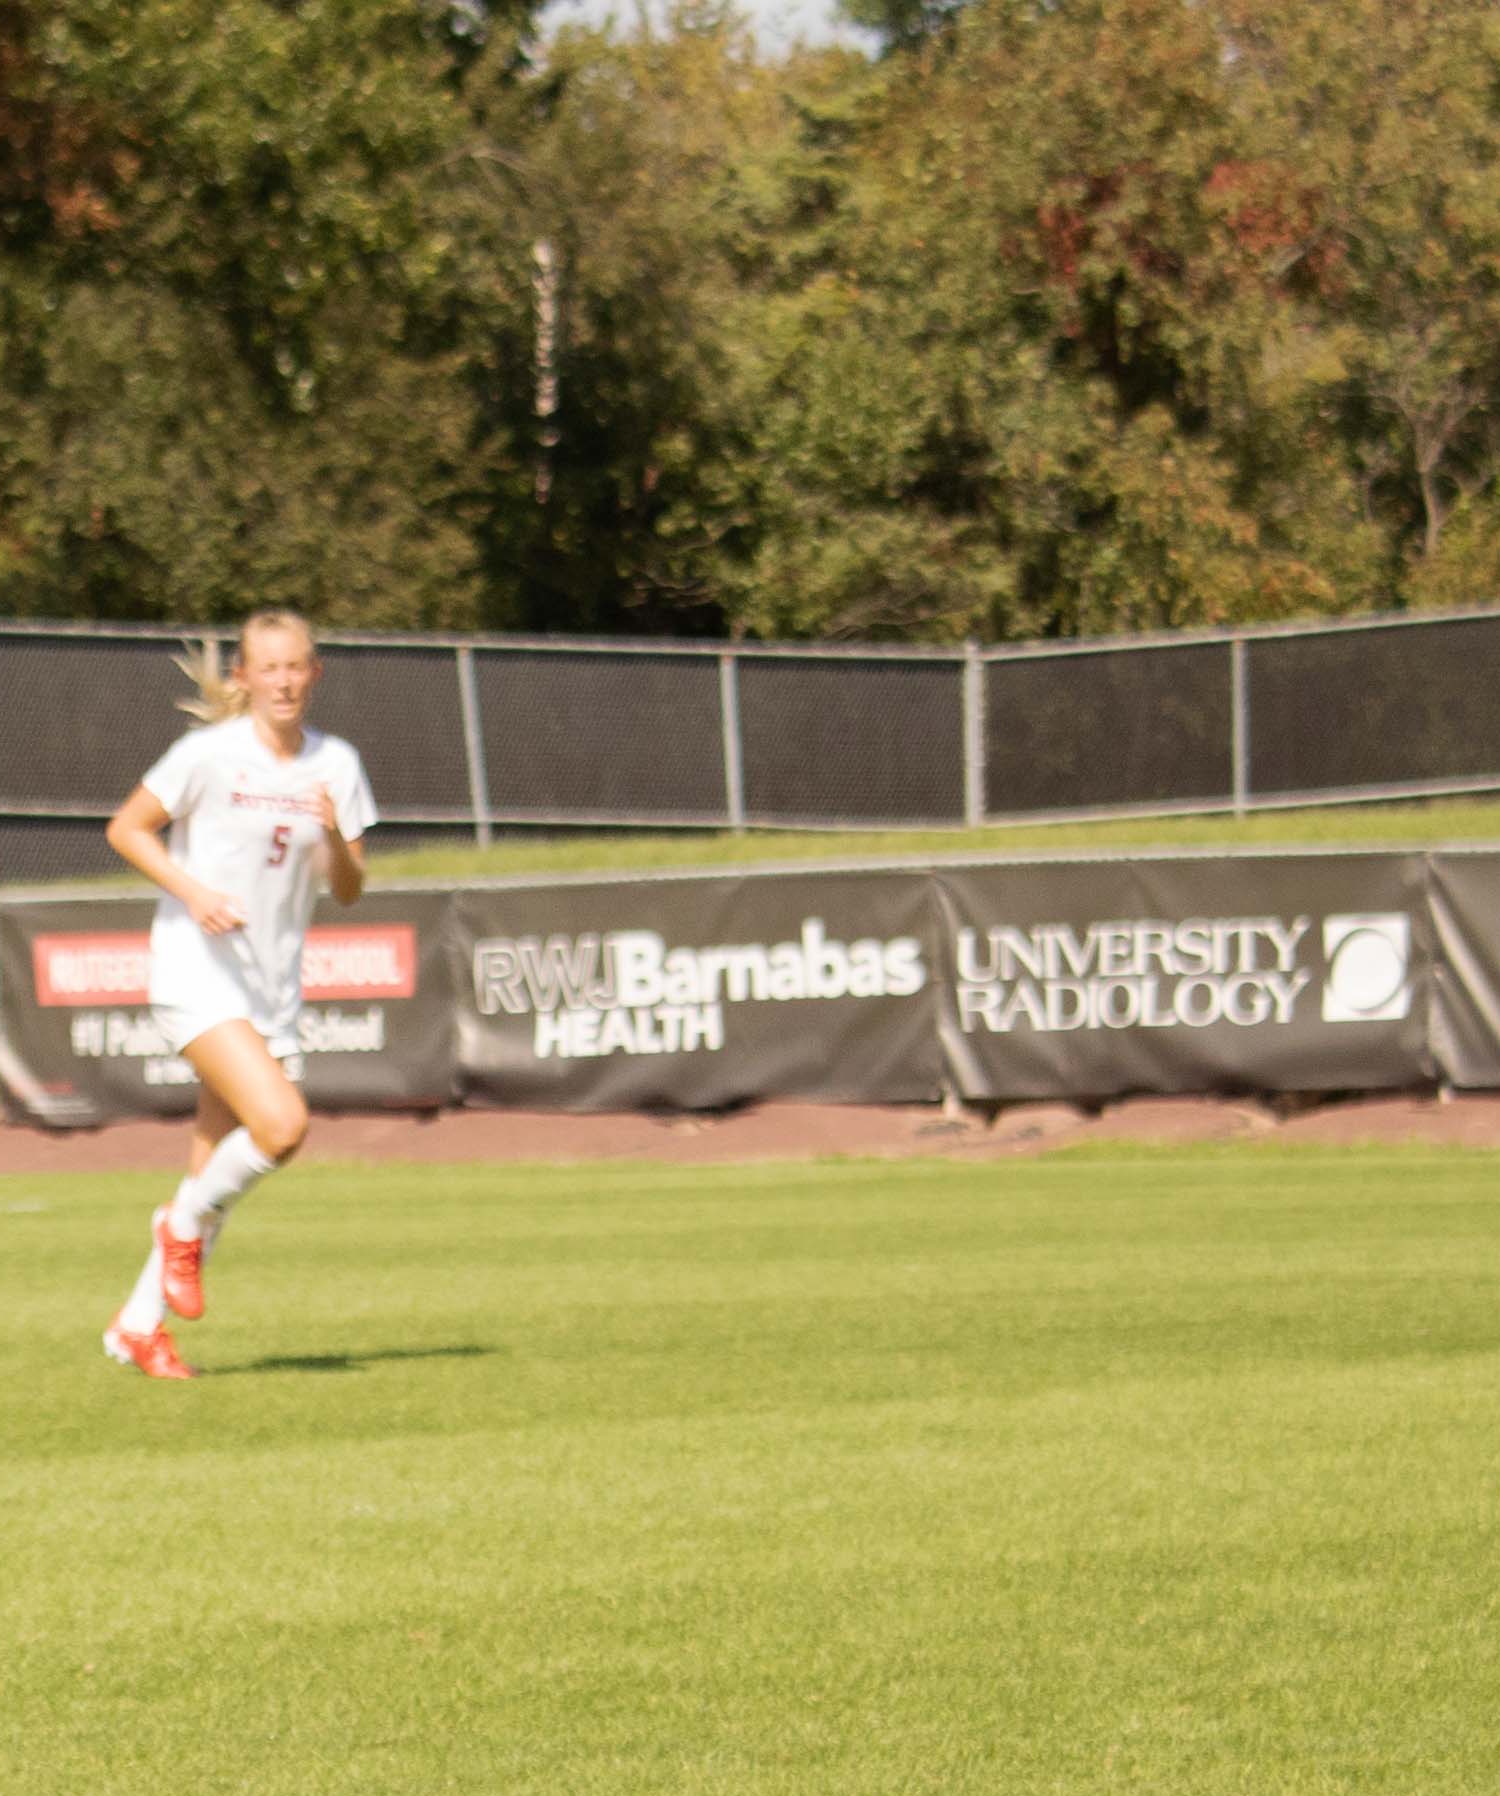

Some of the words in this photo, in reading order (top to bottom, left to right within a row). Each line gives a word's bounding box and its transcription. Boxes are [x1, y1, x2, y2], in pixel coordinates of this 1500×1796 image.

[265, 826, 293, 867] 5
[957, 915, 1312, 982] UNIVERSITY
[535, 1002, 723, 1058] HEALTH
[957, 967, 1311, 1033] RADIOLOGY
